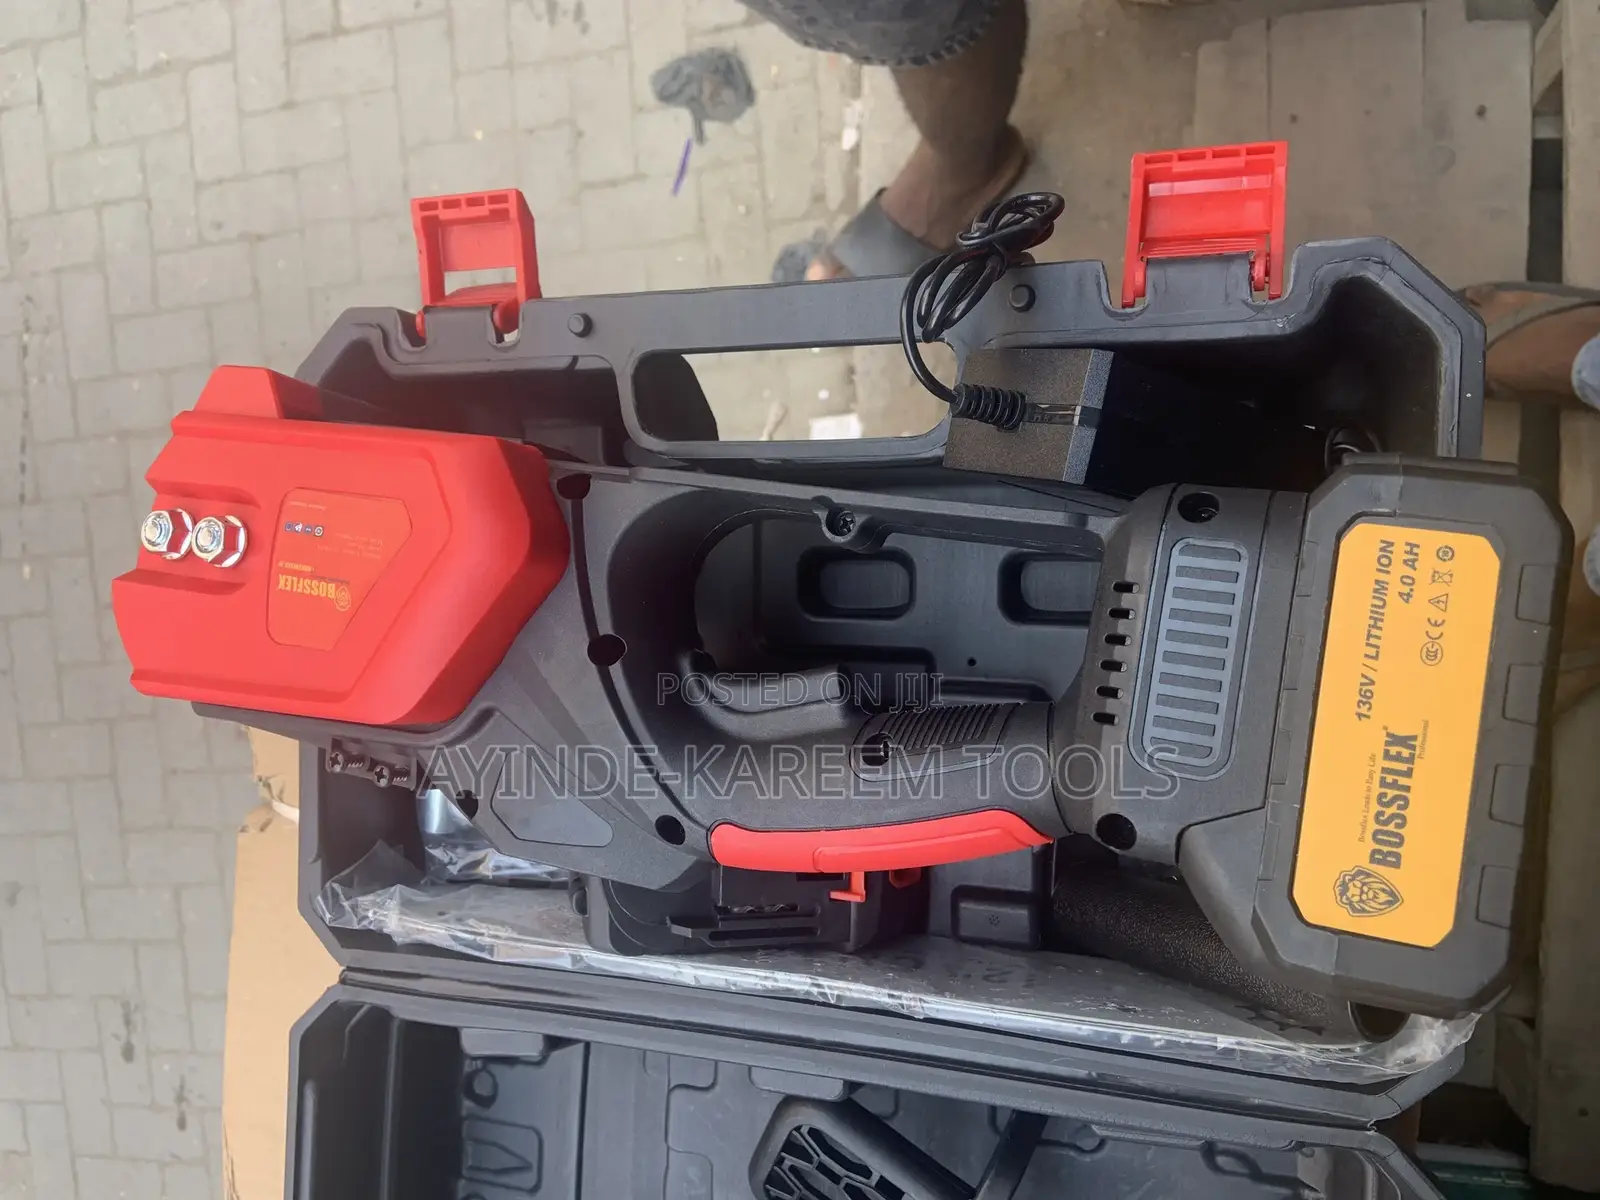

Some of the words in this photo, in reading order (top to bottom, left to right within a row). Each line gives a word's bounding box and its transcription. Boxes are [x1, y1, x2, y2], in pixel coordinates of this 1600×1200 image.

[1376, 539, 1396, 575] ION
[1402, 541, 1421, 572] AH
[278, 573, 336, 600] BOSSFLEX
[1398, 575, 1416, 604] 4.0
[1364, 579, 1390, 661] LITHIUM
[1355, 673, 1377, 722] 136V
[1367, 752, 1376, 767] Life
[1366, 769, 1376, 785] Easy
[1369, 731, 1418, 869] BOSSFLEX
